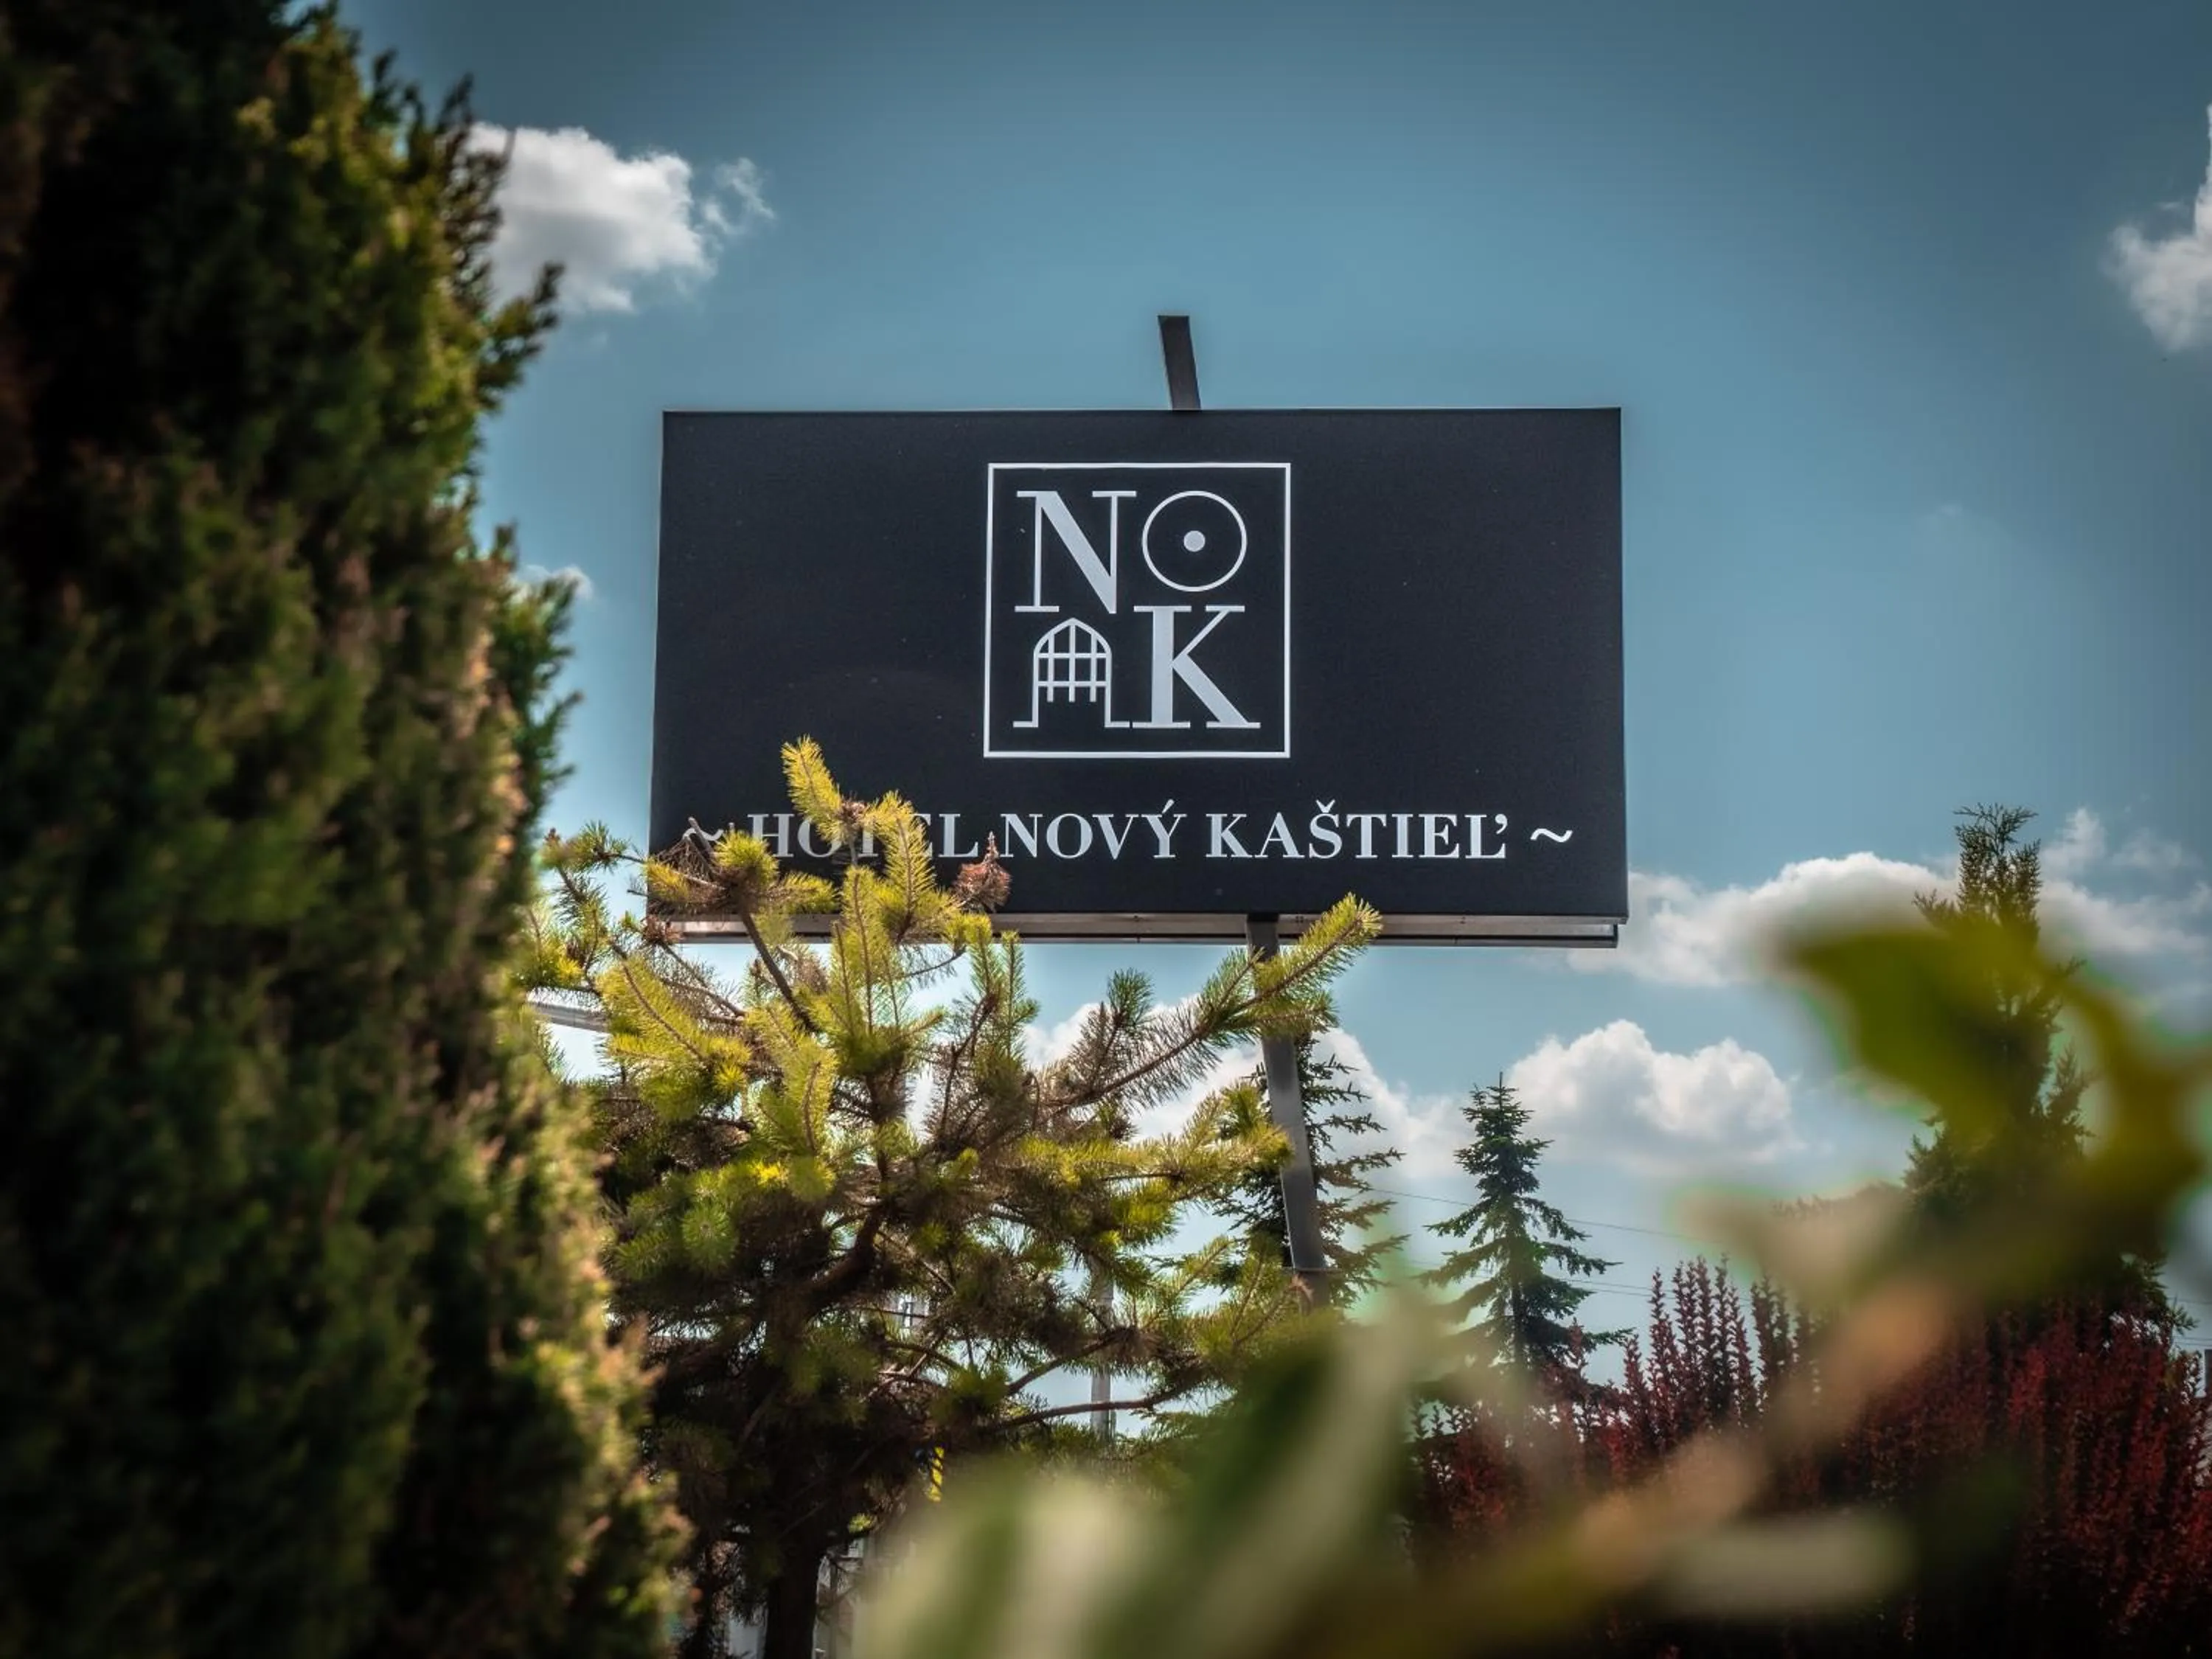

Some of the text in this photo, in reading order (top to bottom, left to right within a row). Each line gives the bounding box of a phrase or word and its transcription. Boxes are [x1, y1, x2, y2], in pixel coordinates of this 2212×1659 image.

[747, 799, 1508, 859] HOL NOVÝ KAŠTIEĽ
